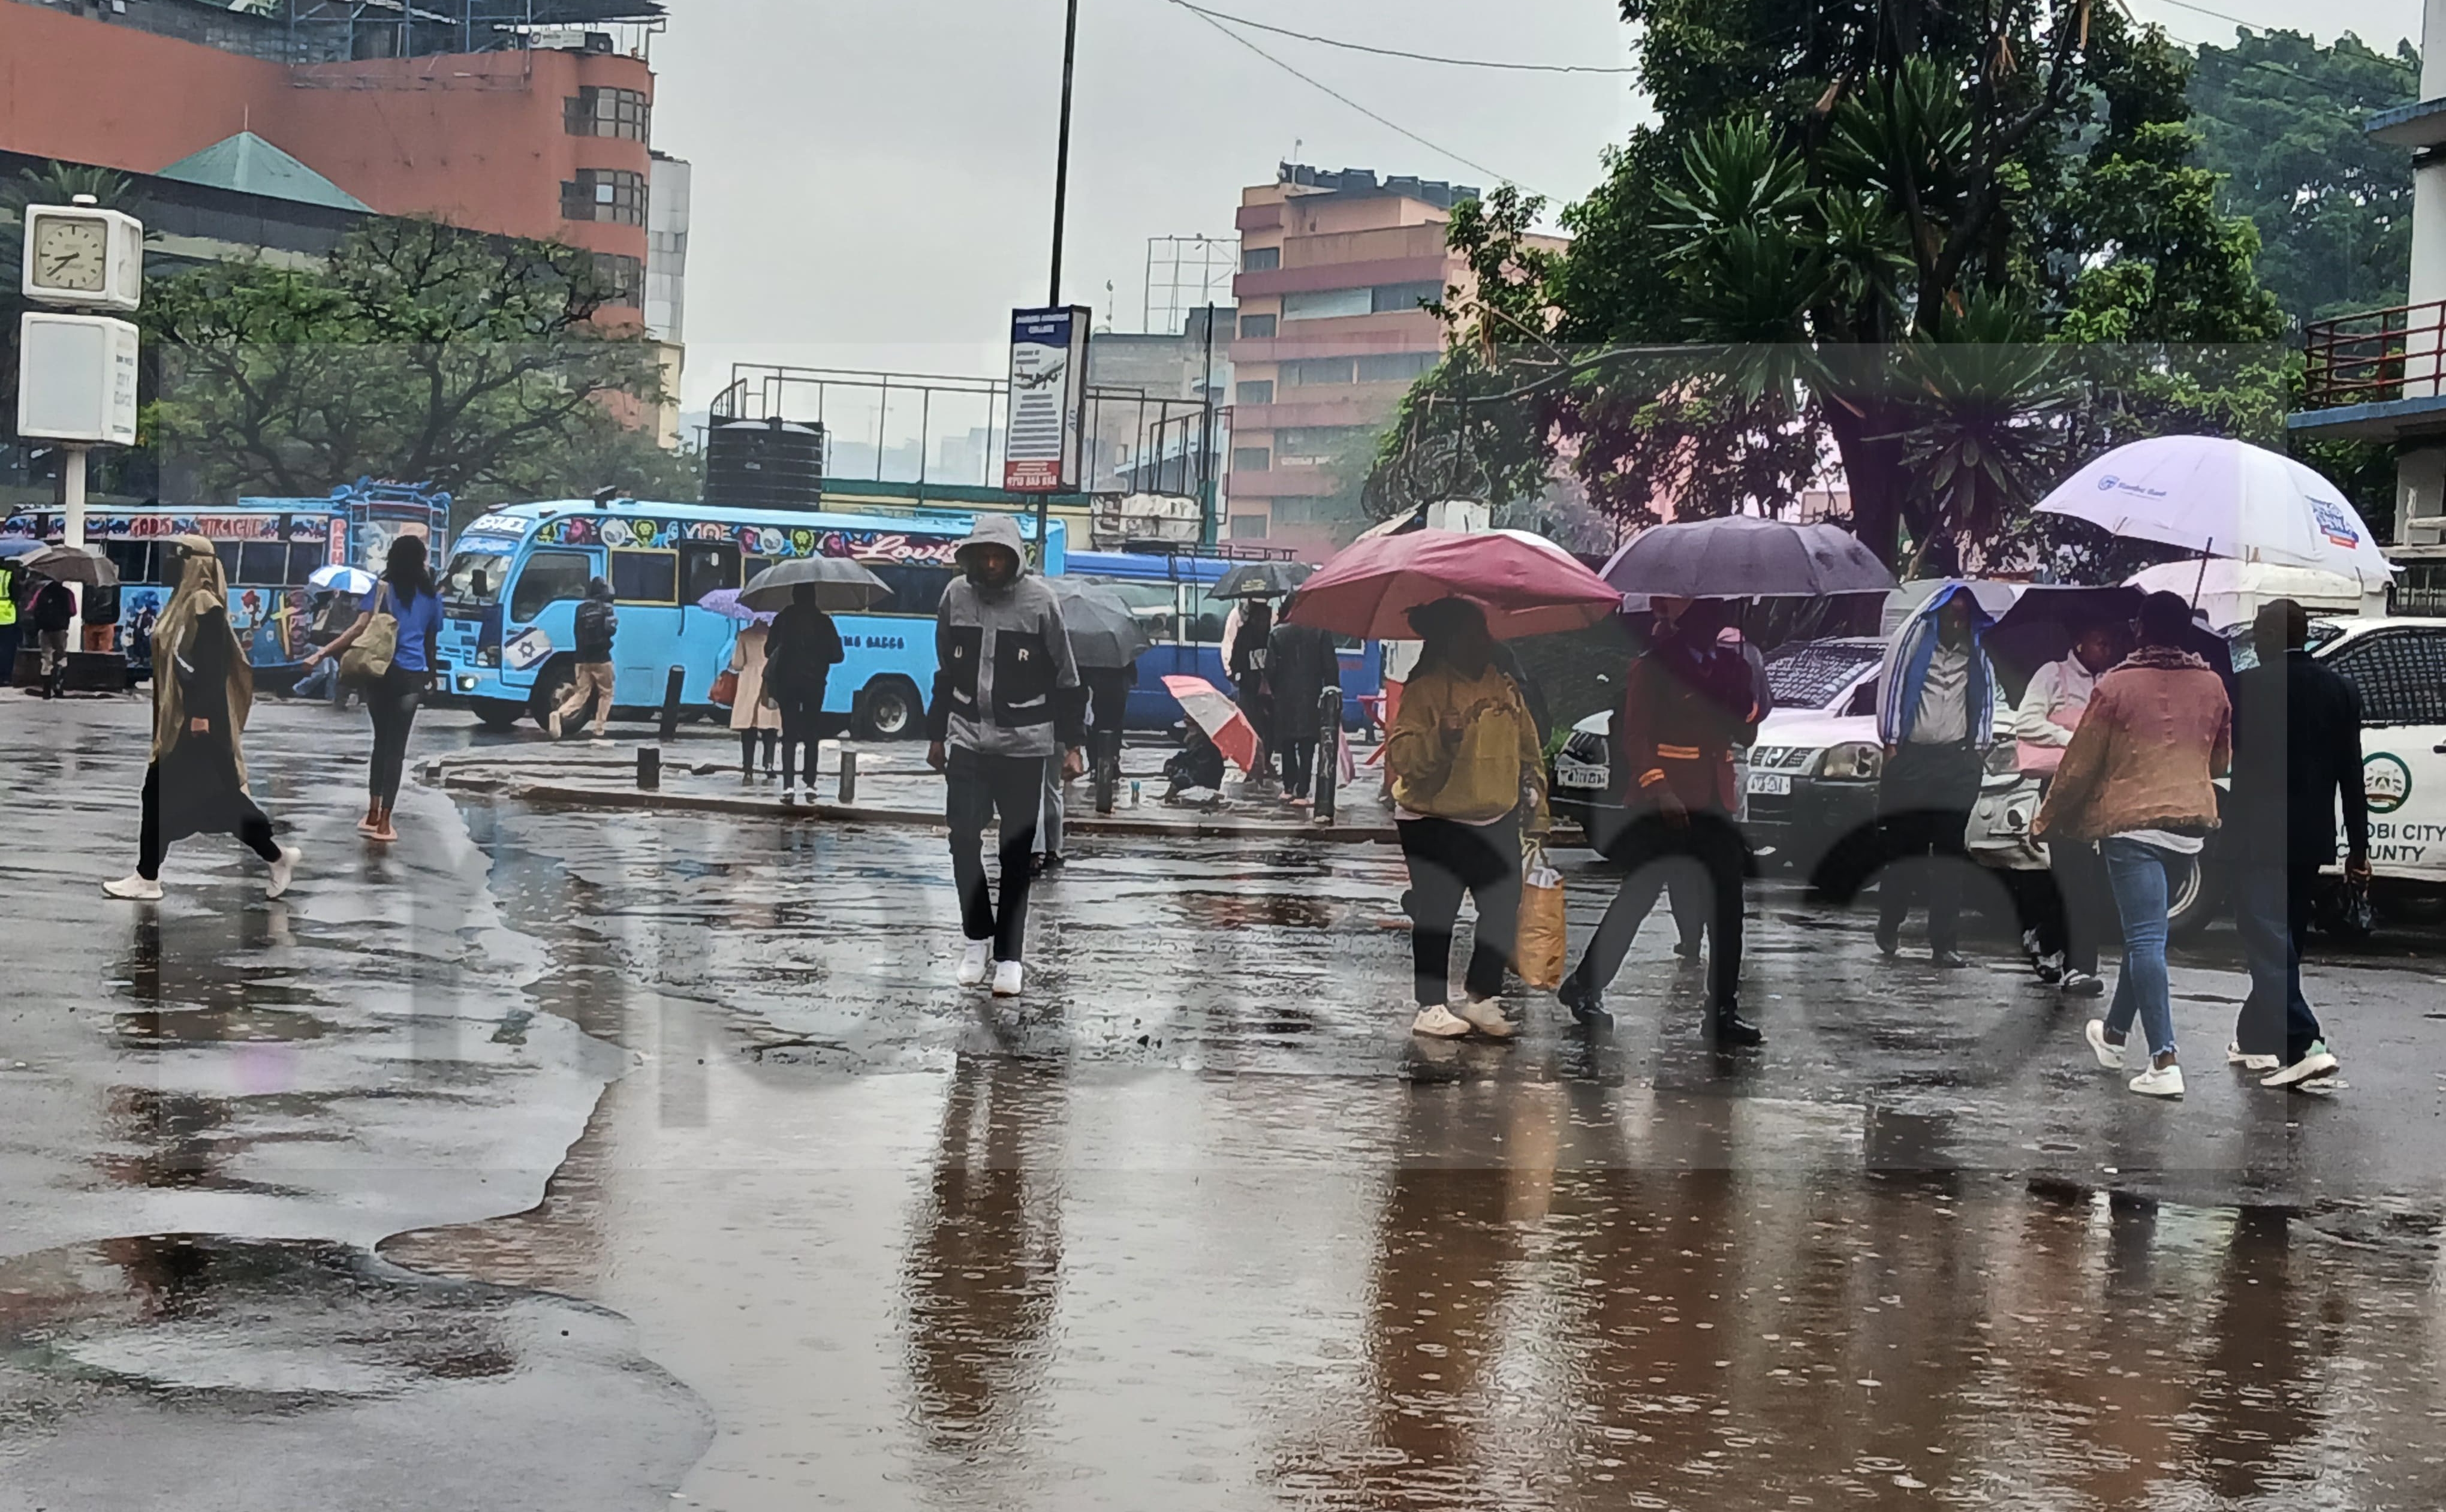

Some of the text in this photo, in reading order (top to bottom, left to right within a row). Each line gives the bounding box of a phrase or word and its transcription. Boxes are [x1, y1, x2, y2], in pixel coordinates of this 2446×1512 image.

[1018, 648, 1029, 662] R
[2403, 825, 2446, 841] CITY
[2336, 844, 2426, 862] CUNTY
